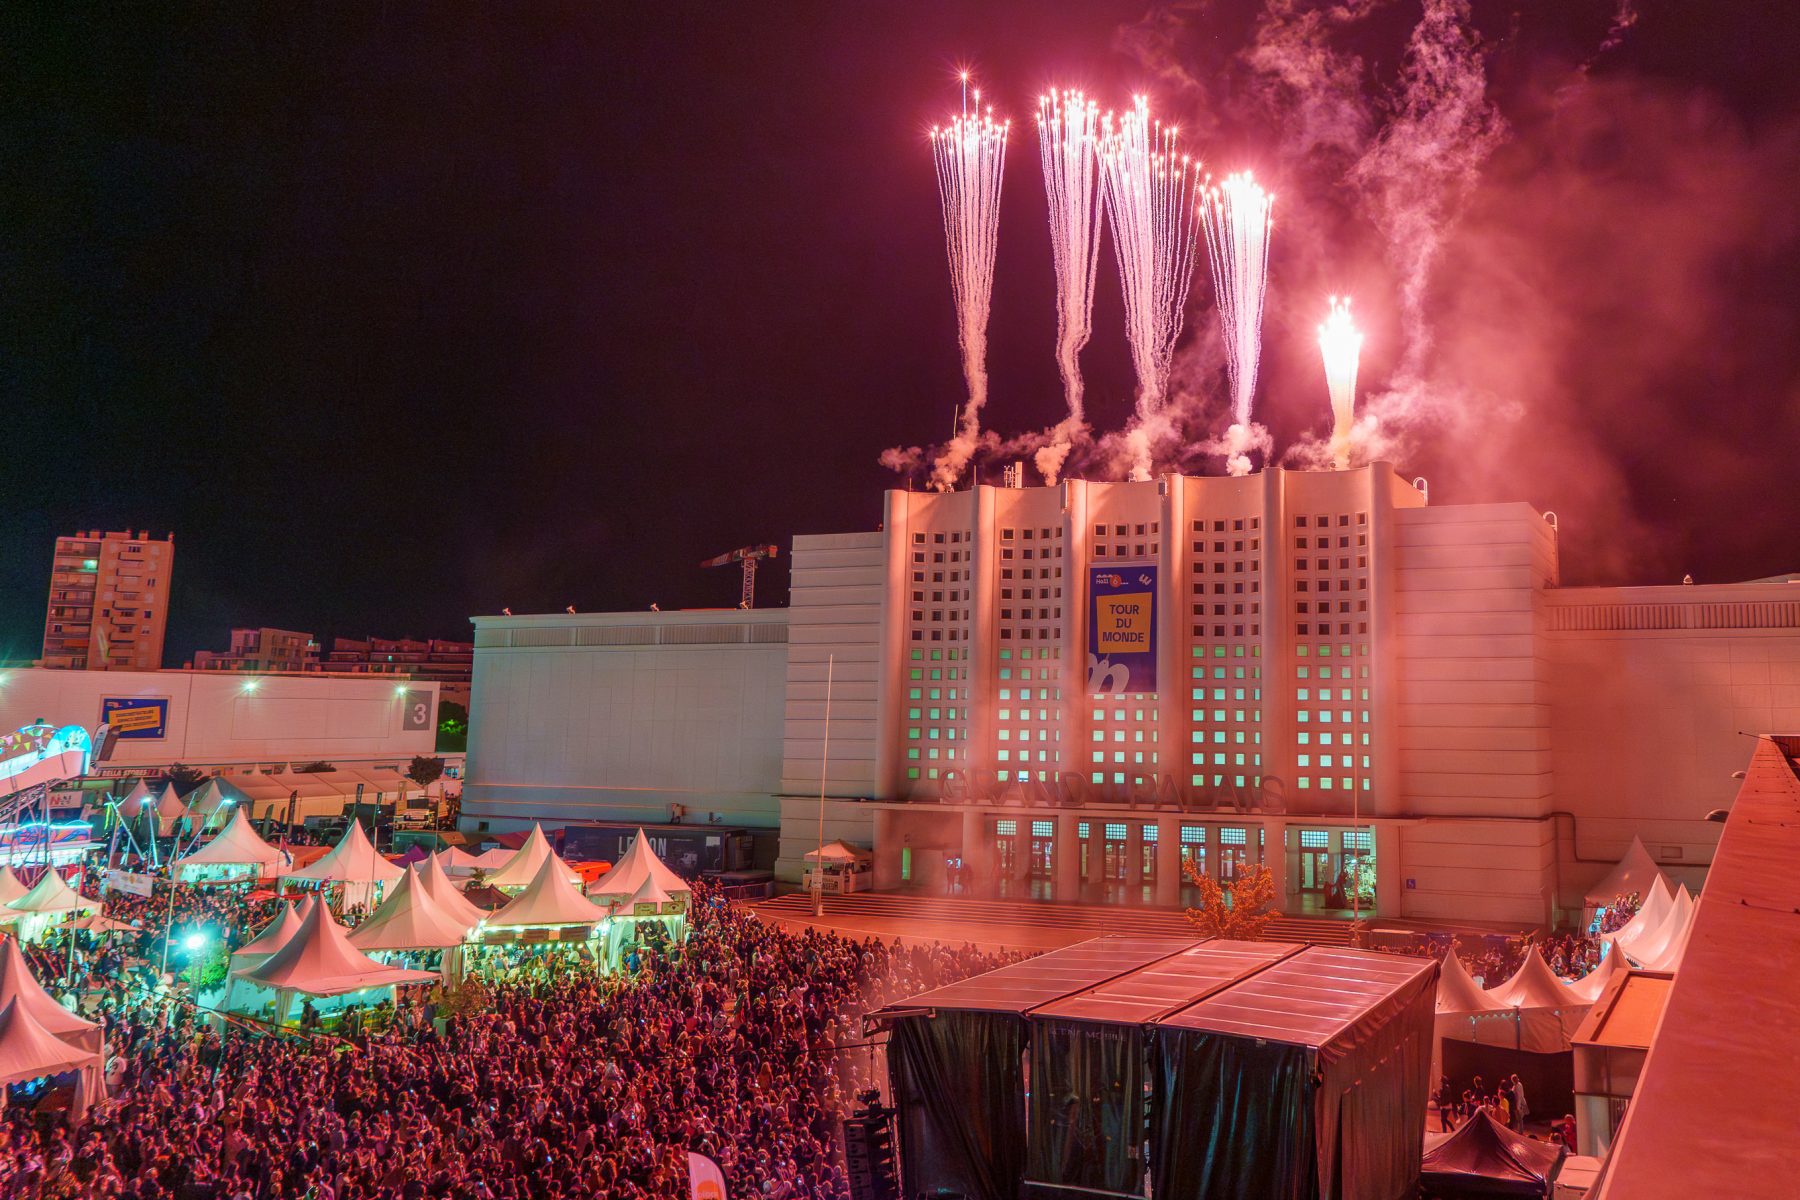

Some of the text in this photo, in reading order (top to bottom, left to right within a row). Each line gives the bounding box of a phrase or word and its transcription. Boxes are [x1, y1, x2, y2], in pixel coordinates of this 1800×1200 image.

[1109, 604, 1140, 615] TOUR
[1115, 618, 1132, 629] DU
[1102, 631, 1145, 643] MONDE
[413, 703, 427, 725] 3
[938, 768, 1288, 815] GRAND PALAIS
